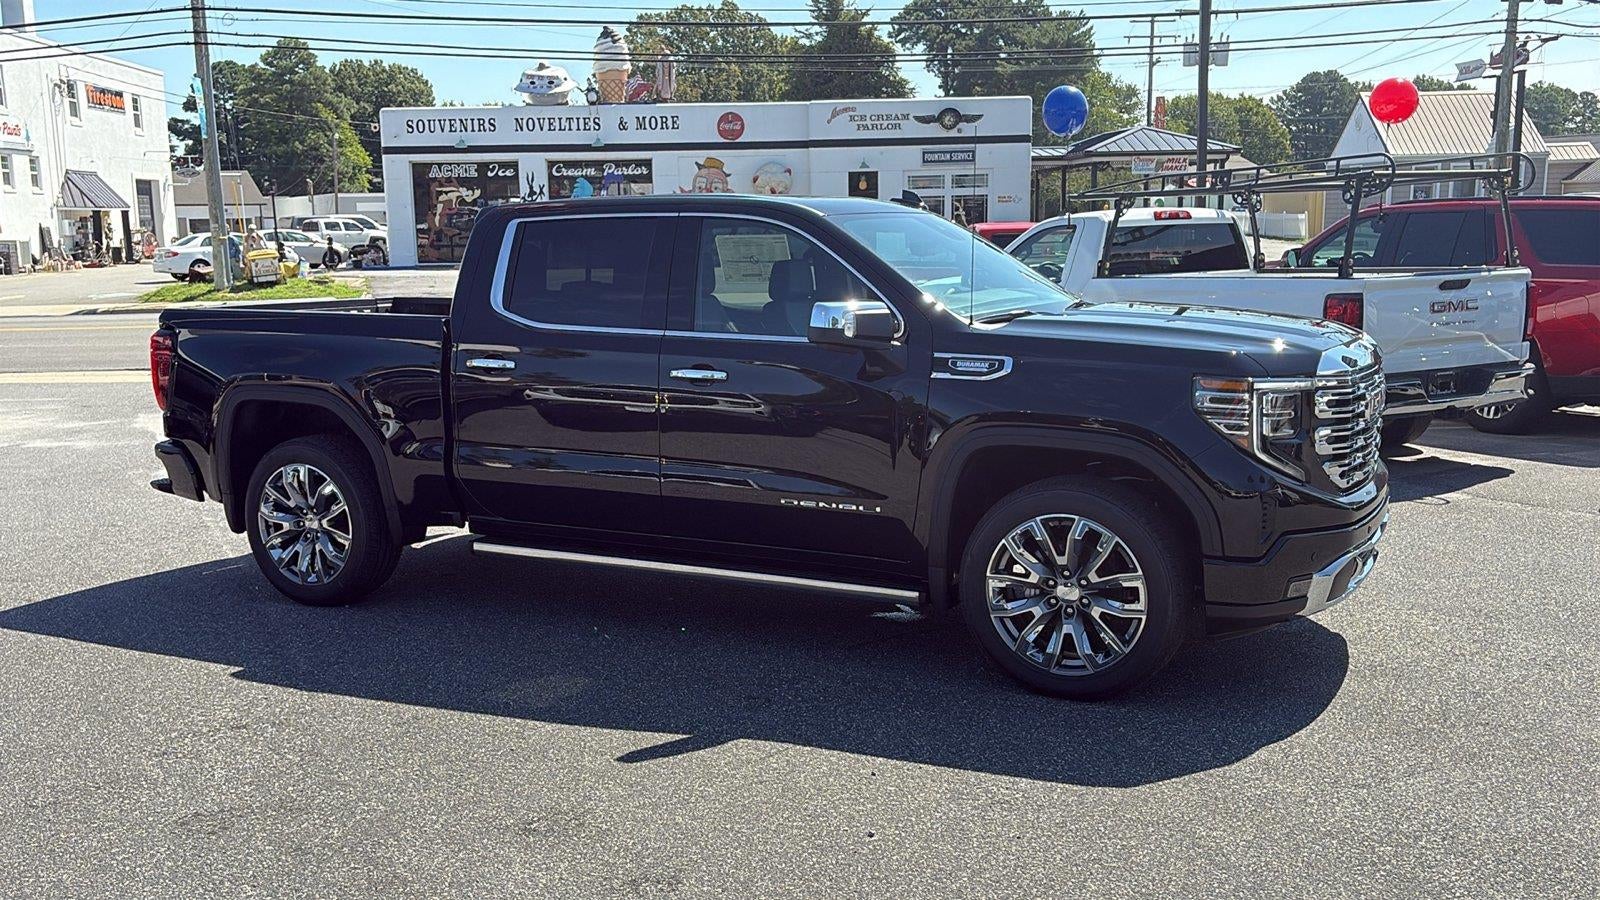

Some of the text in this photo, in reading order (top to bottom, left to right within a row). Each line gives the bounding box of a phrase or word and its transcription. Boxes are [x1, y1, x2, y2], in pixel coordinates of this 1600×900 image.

[86, 84, 125, 109] Firestone
[406, 115, 680, 134] SOUVENIRS NOVELTIES & MORE
[848, 113, 911, 122] ICE CREAM
[856, 122, 902, 131] PARLOR
[924, 152, 973, 161] FOUNTAIN SERVICE
[429, 163, 516, 178] ACME Ice
[552, 162, 650, 177] Cream Parlor
[1430, 299, 1479, 314] GMC
[781, 499, 881, 512] DENALI
